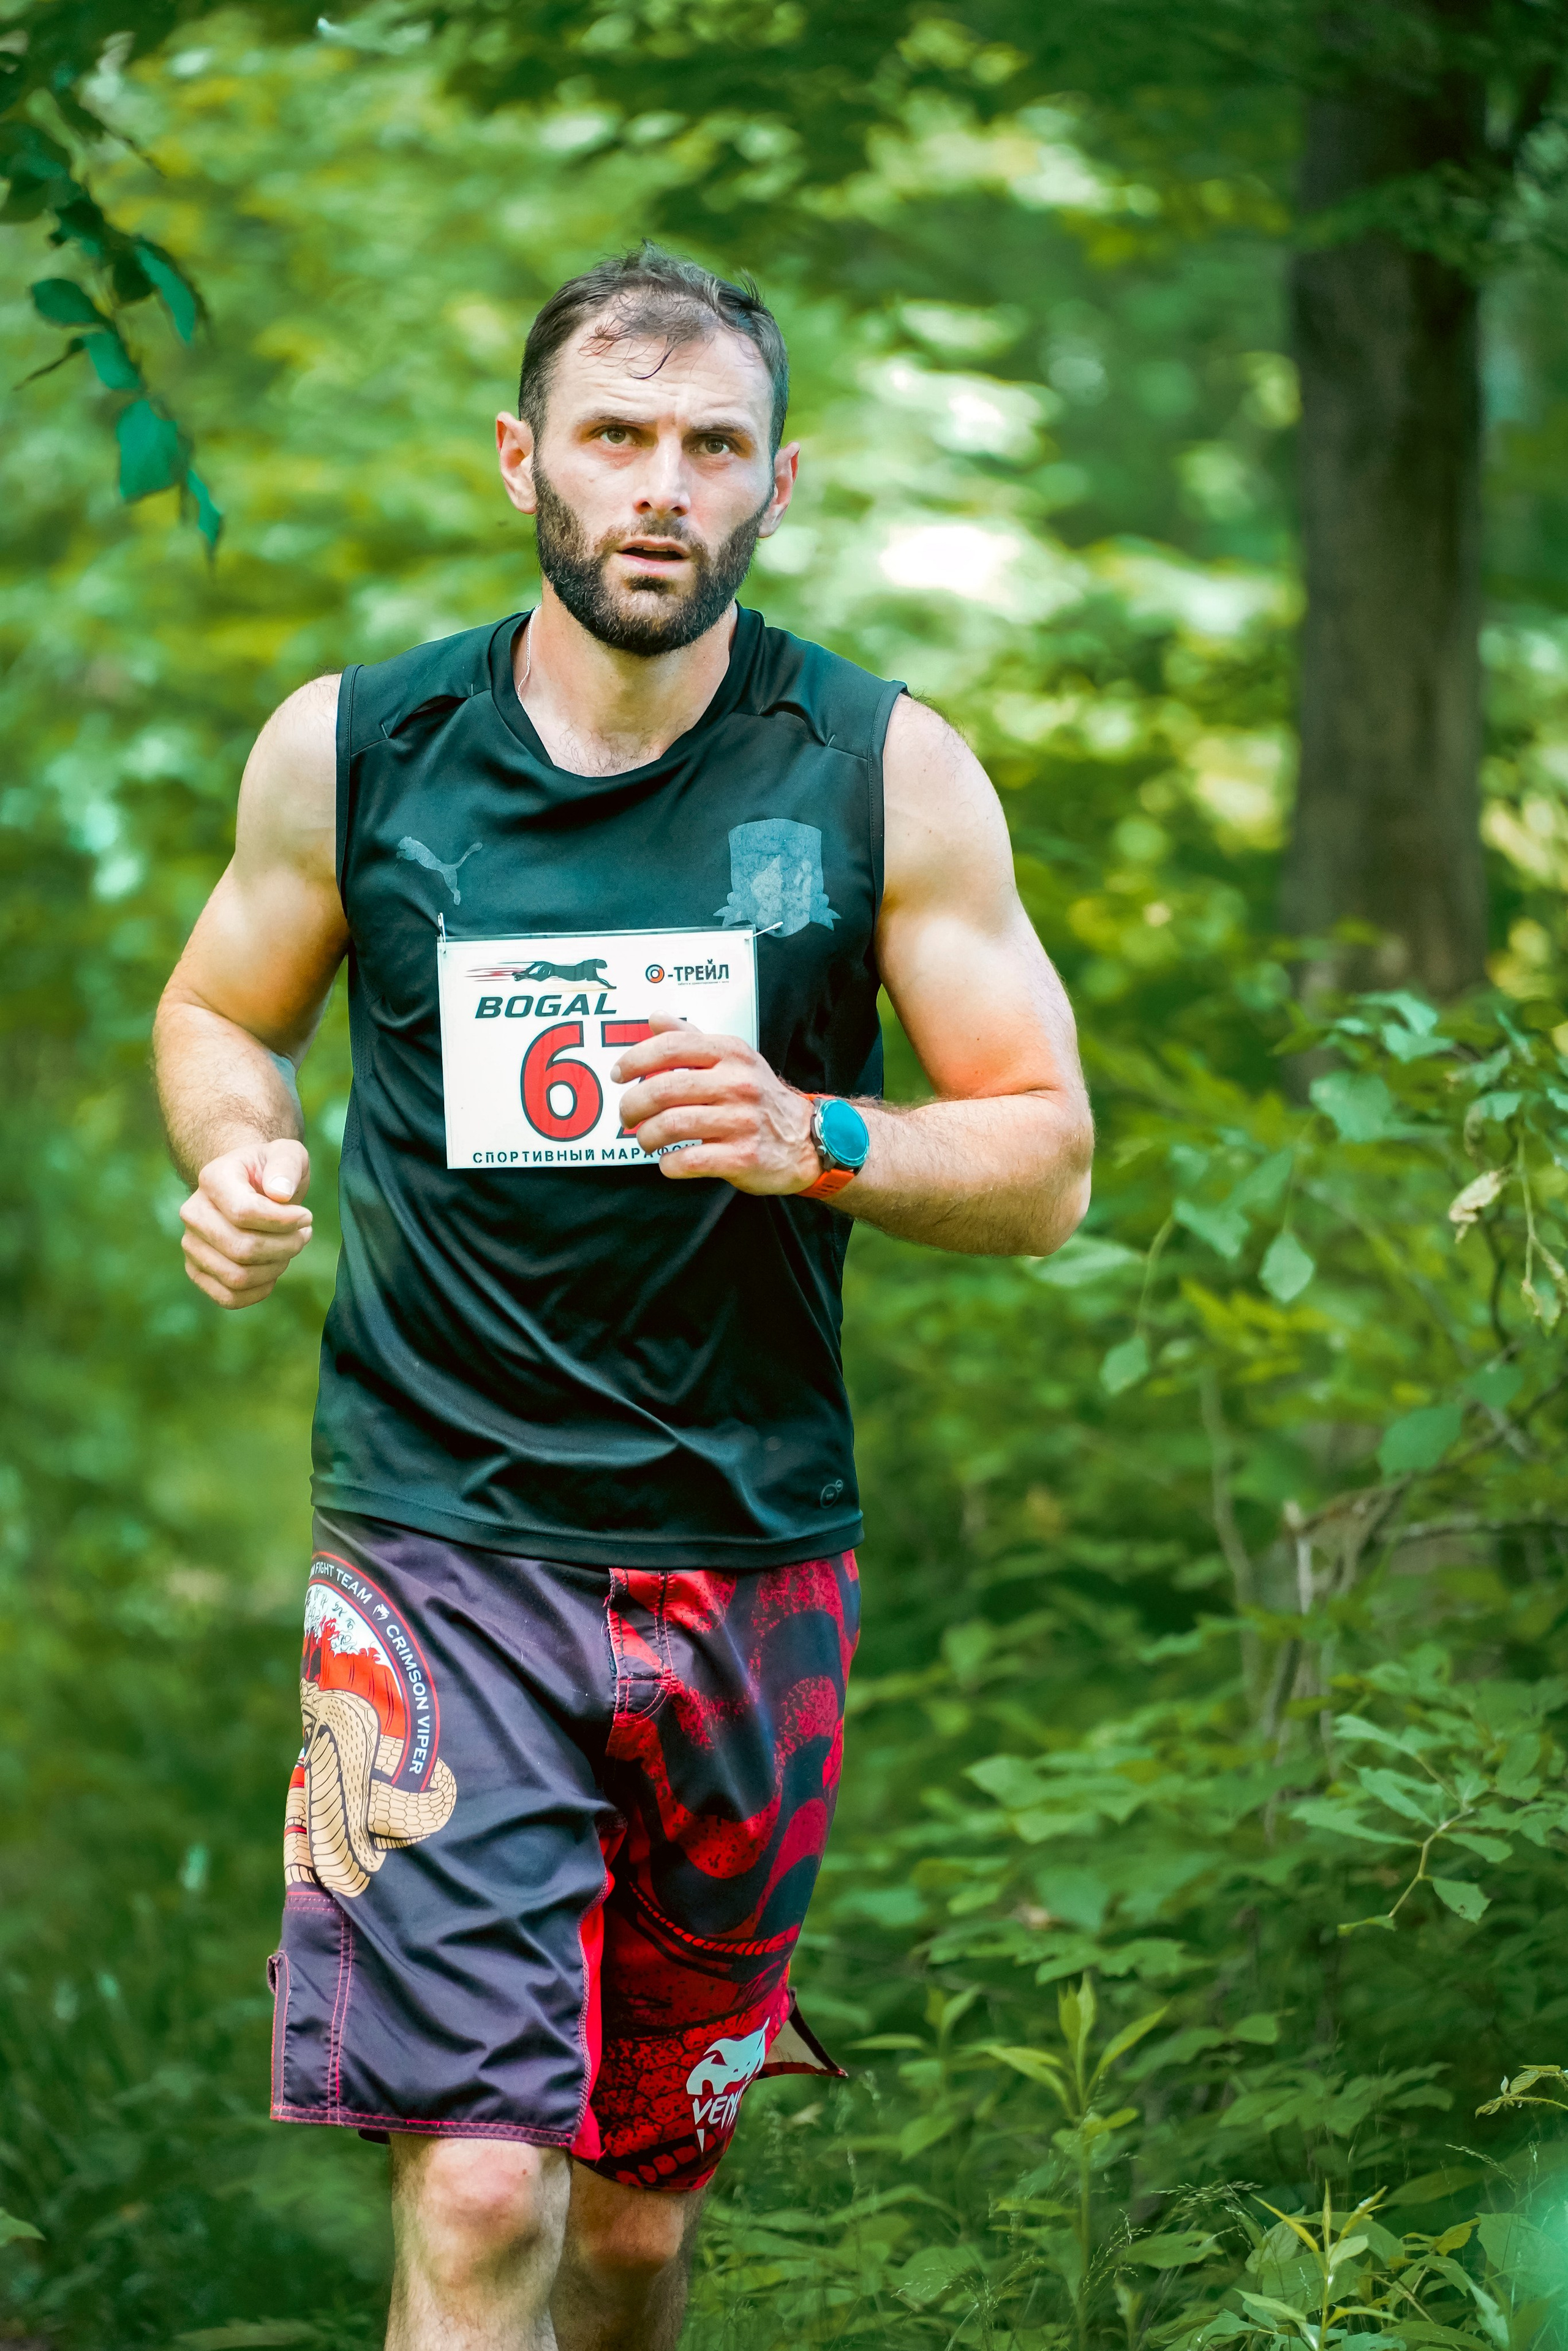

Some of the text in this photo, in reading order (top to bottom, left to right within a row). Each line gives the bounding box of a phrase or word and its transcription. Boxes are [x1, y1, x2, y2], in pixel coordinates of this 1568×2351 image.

[475, 993, 617, 1019] BOGAL
[472, 1143, 695, 1163] СПОРТИВНЫЙ МАРФ
[315, 1561, 430, 1775] FIGHT TEAM CRIMSON VIPER
[692, 2086, 744, 2130] VEN
